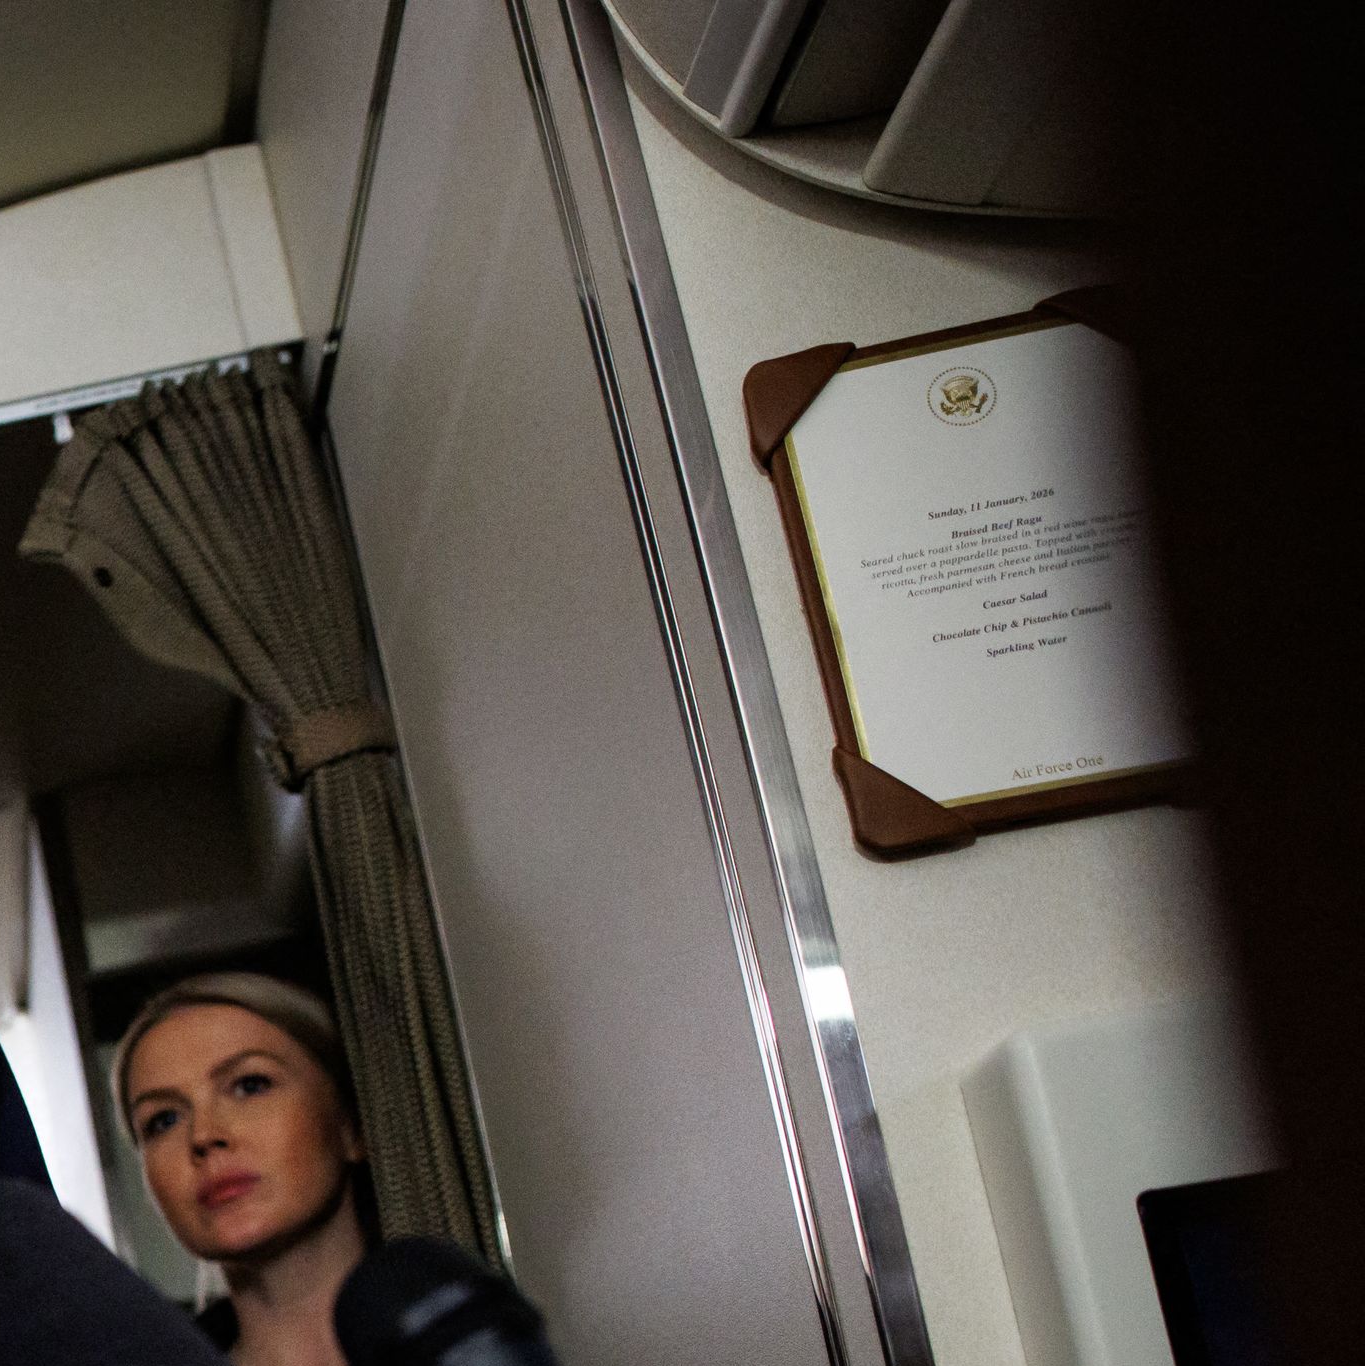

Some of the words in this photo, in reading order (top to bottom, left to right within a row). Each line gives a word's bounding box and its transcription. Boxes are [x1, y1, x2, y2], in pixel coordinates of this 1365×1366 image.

[928, 507, 967, 520] Sunday,
[971, 502, 980, 512] 11
[984, 497, 1027, 509] January,
[1031, 489, 1054, 500] 2026
[860, 555, 893, 568] Seared
[896, 549, 925, 562] chuck
[928, 545, 953, 555] roast
[955, 541, 978, 551] slow
[981, 529, 1018, 545] braised
[1021, 529, 1032, 537] in
[1044, 523, 1060, 534] red
[1063, 518, 1086, 529] wine
[952, 525, 988, 539] Braised
[991, 519, 1014, 531] Beef
[1016, 516, 1042, 527] Ragu
[871, 567, 903, 579] served
[906, 562, 927, 572] over
[939, 548, 998, 570] pappardelle
[1001, 545, 1031, 558] pasta.
[1036, 534, 1072, 548] Topped
[1075, 528, 1097, 540] with
[881, 578, 917, 590] ricotta,
[919, 573, 944, 585] fresh
[947, 563, 995, 579] parmesan
[999, 557, 1030, 568] cheese
[1034, 551, 1053, 561] and
[1056, 545, 1091, 556] Italian
[907, 578, 972, 598] Accompanied
[975, 574, 997, 585] with
[1000, 568, 1035, 581] French
[1039, 559, 1067, 572] bread
[982, 597, 1016, 610] Caesar
[1019, 590, 1047, 602] Salad
[933, 627, 981, 643] Chocolate
[984, 622, 1008, 634] Chip
[1010, 619, 1019, 628] &
[1022, 612, 1068, 627] Pistachio
[1071, 603, 1112, 617] Cannoli
[987, 643, 1035, 657] Sparkling
[1037, 637, 1067, 649] Water
[1012, 767, 1032, 780] Air
[1036, 762, 1073, 776] Force
[1076, 757, 1104, 768] One
